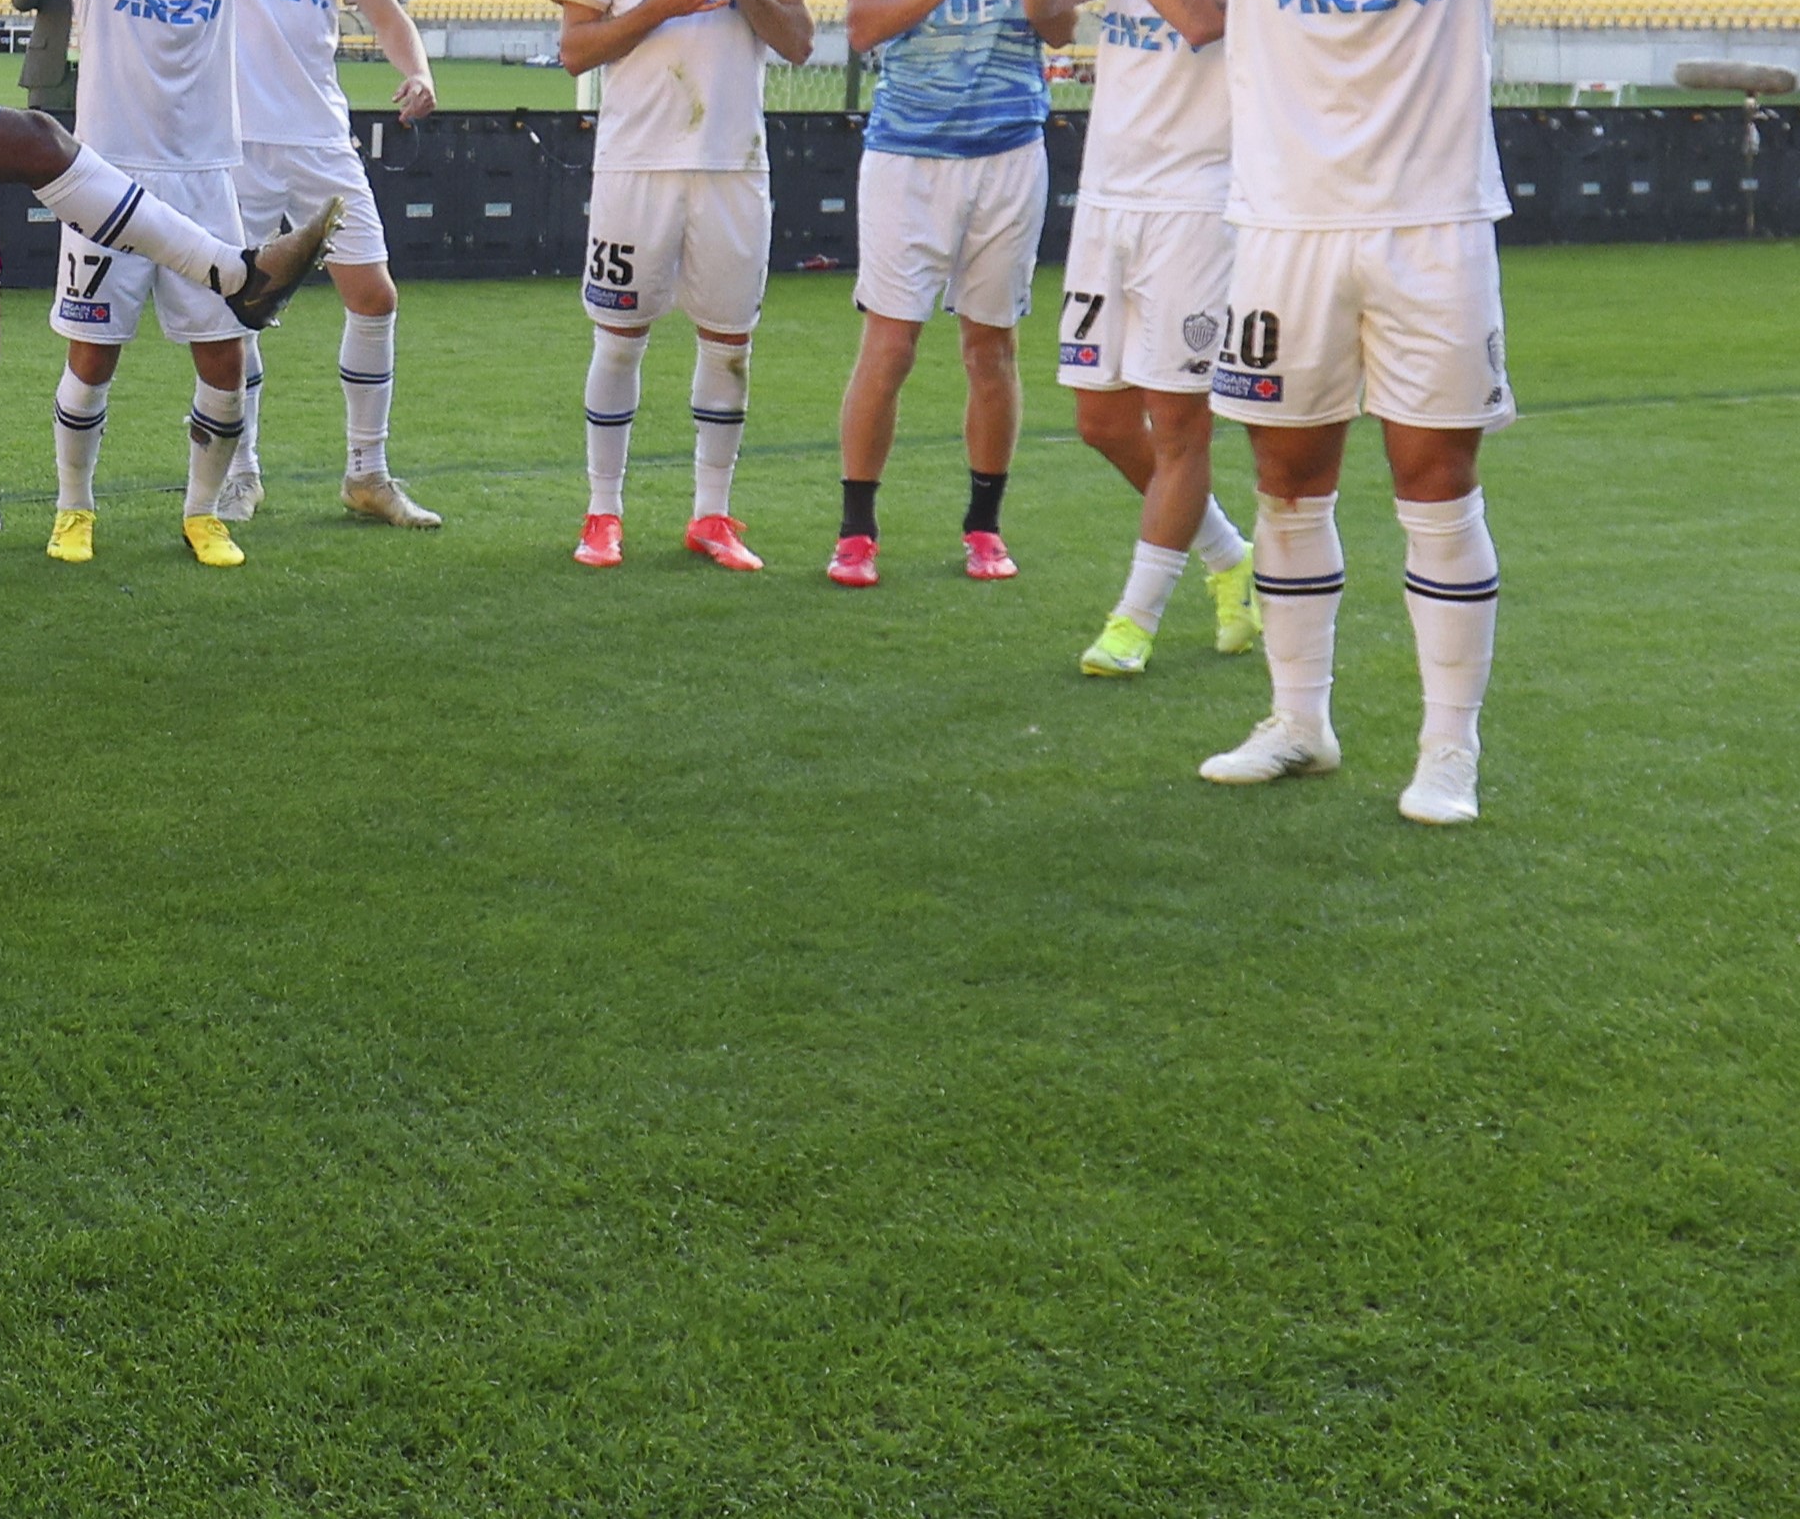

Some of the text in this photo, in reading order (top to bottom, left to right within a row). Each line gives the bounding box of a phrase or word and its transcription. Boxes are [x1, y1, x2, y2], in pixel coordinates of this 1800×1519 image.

[1102, 12, 1163, 51] ANZ
[67, 252, 113, 300] 17
[590, 237, 635, 286] 35
